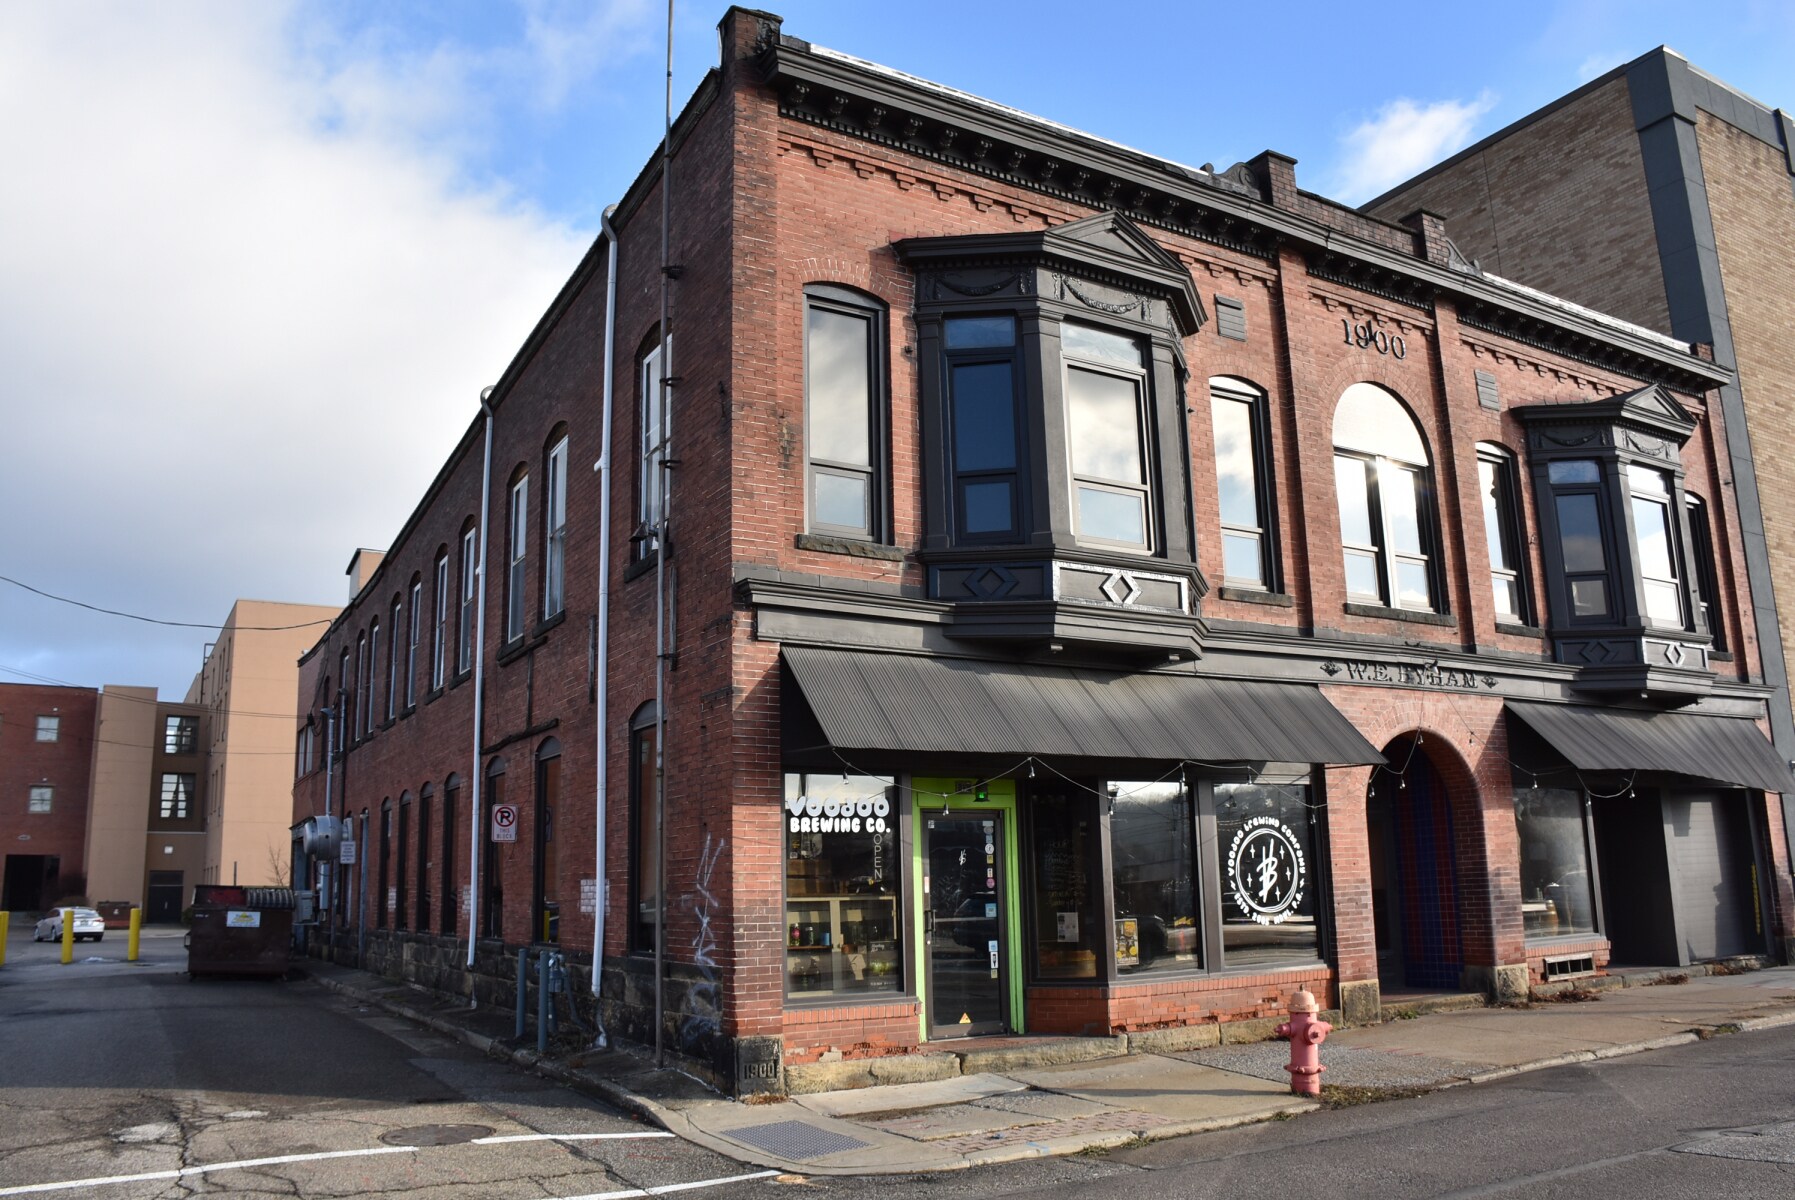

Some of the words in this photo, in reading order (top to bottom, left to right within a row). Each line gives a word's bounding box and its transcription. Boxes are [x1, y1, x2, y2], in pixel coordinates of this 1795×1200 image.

[1341, 319, 1407, 360] 1900
[789, 817, 861, 833] BREWING
[865, 817, 891, 833] CO.
[873, 834, 882, 880] OPEN
